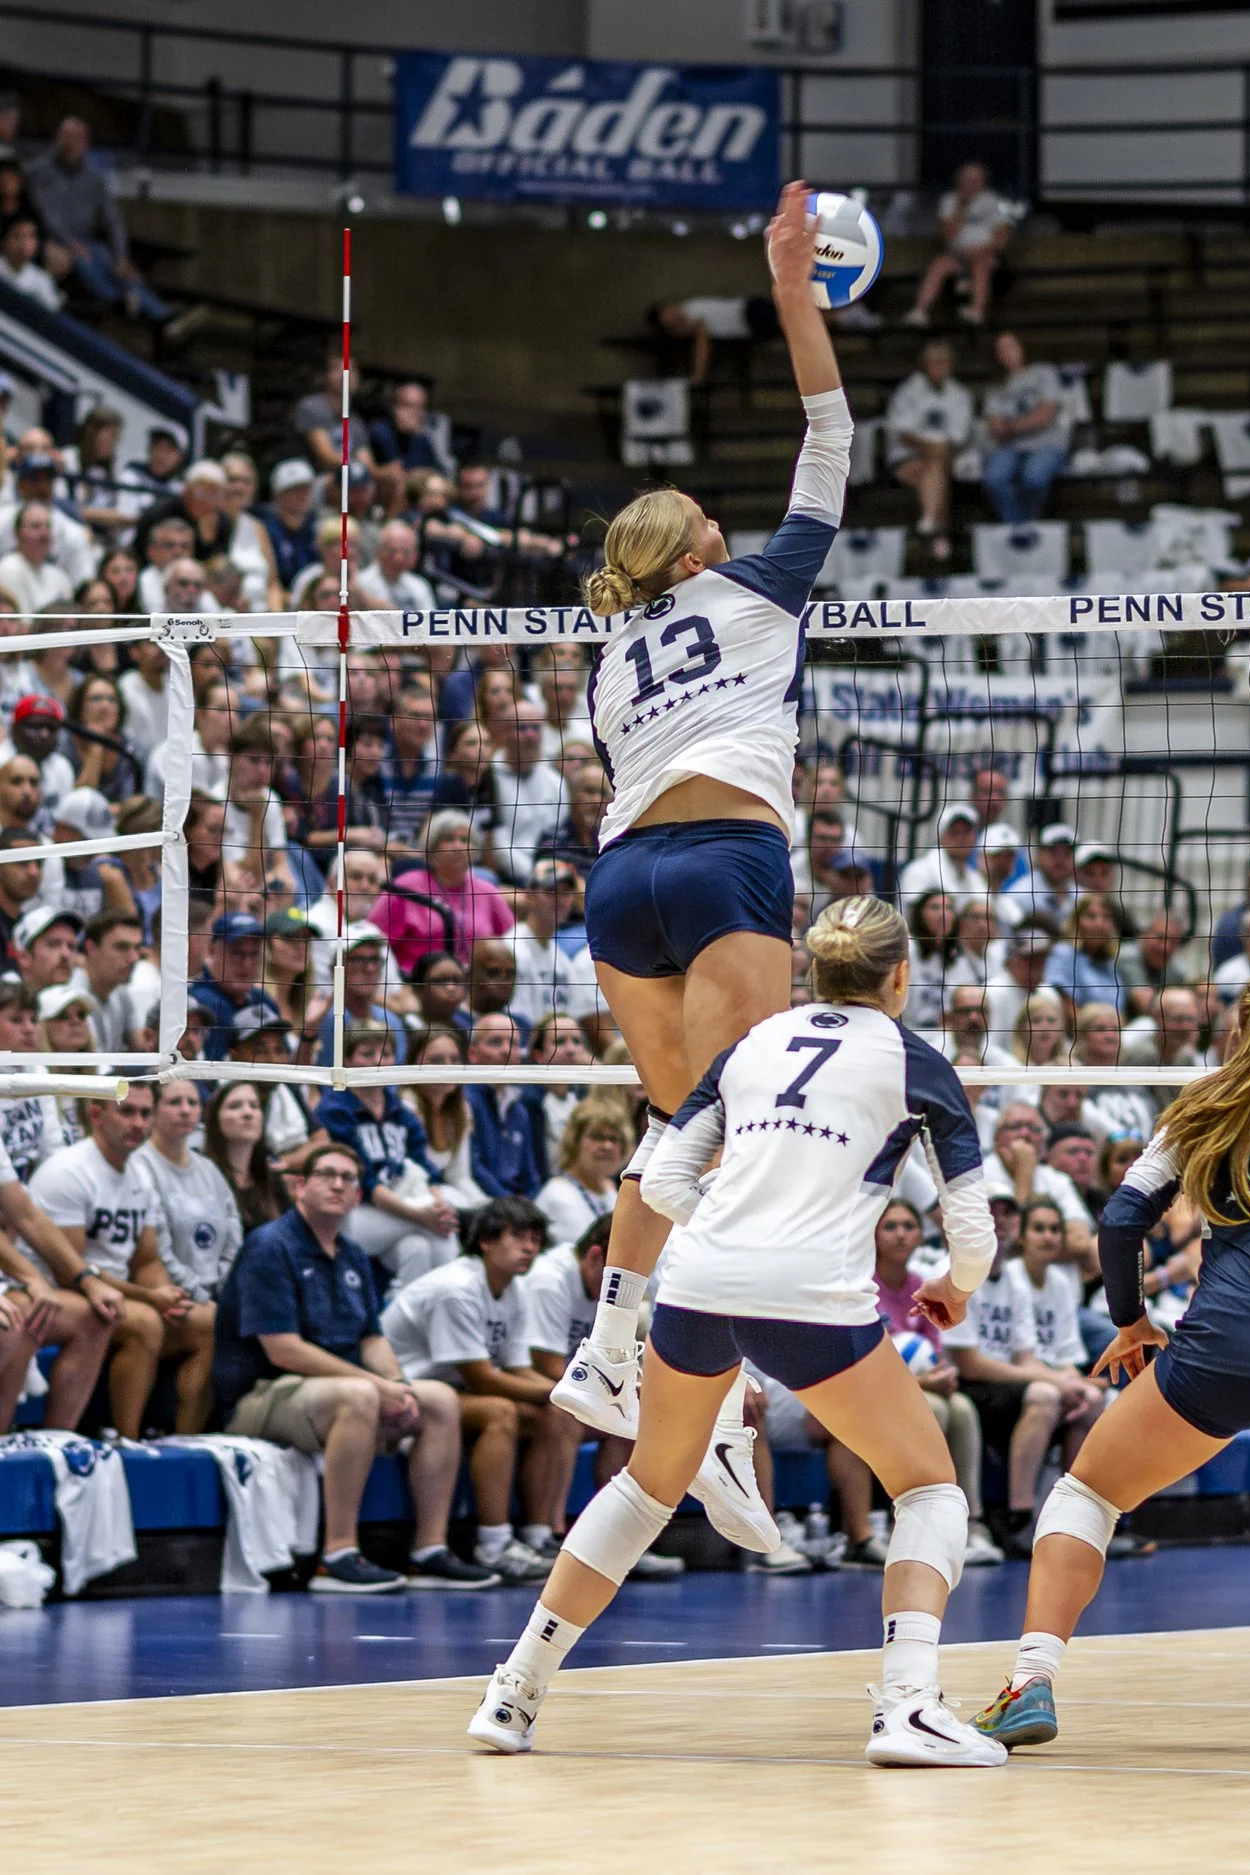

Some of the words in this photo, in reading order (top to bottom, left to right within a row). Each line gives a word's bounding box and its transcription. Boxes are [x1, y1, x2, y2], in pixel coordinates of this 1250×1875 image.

[450, 152, 614, 180] OFFICIAL
[625, 159, 722, 186] BALL
[402, 609, 508, 636] PENN
[1070, 596, 1183, 623] PENN
[624, 614, 721, 705] 13
[774, 1037, 841, 1107] 7
